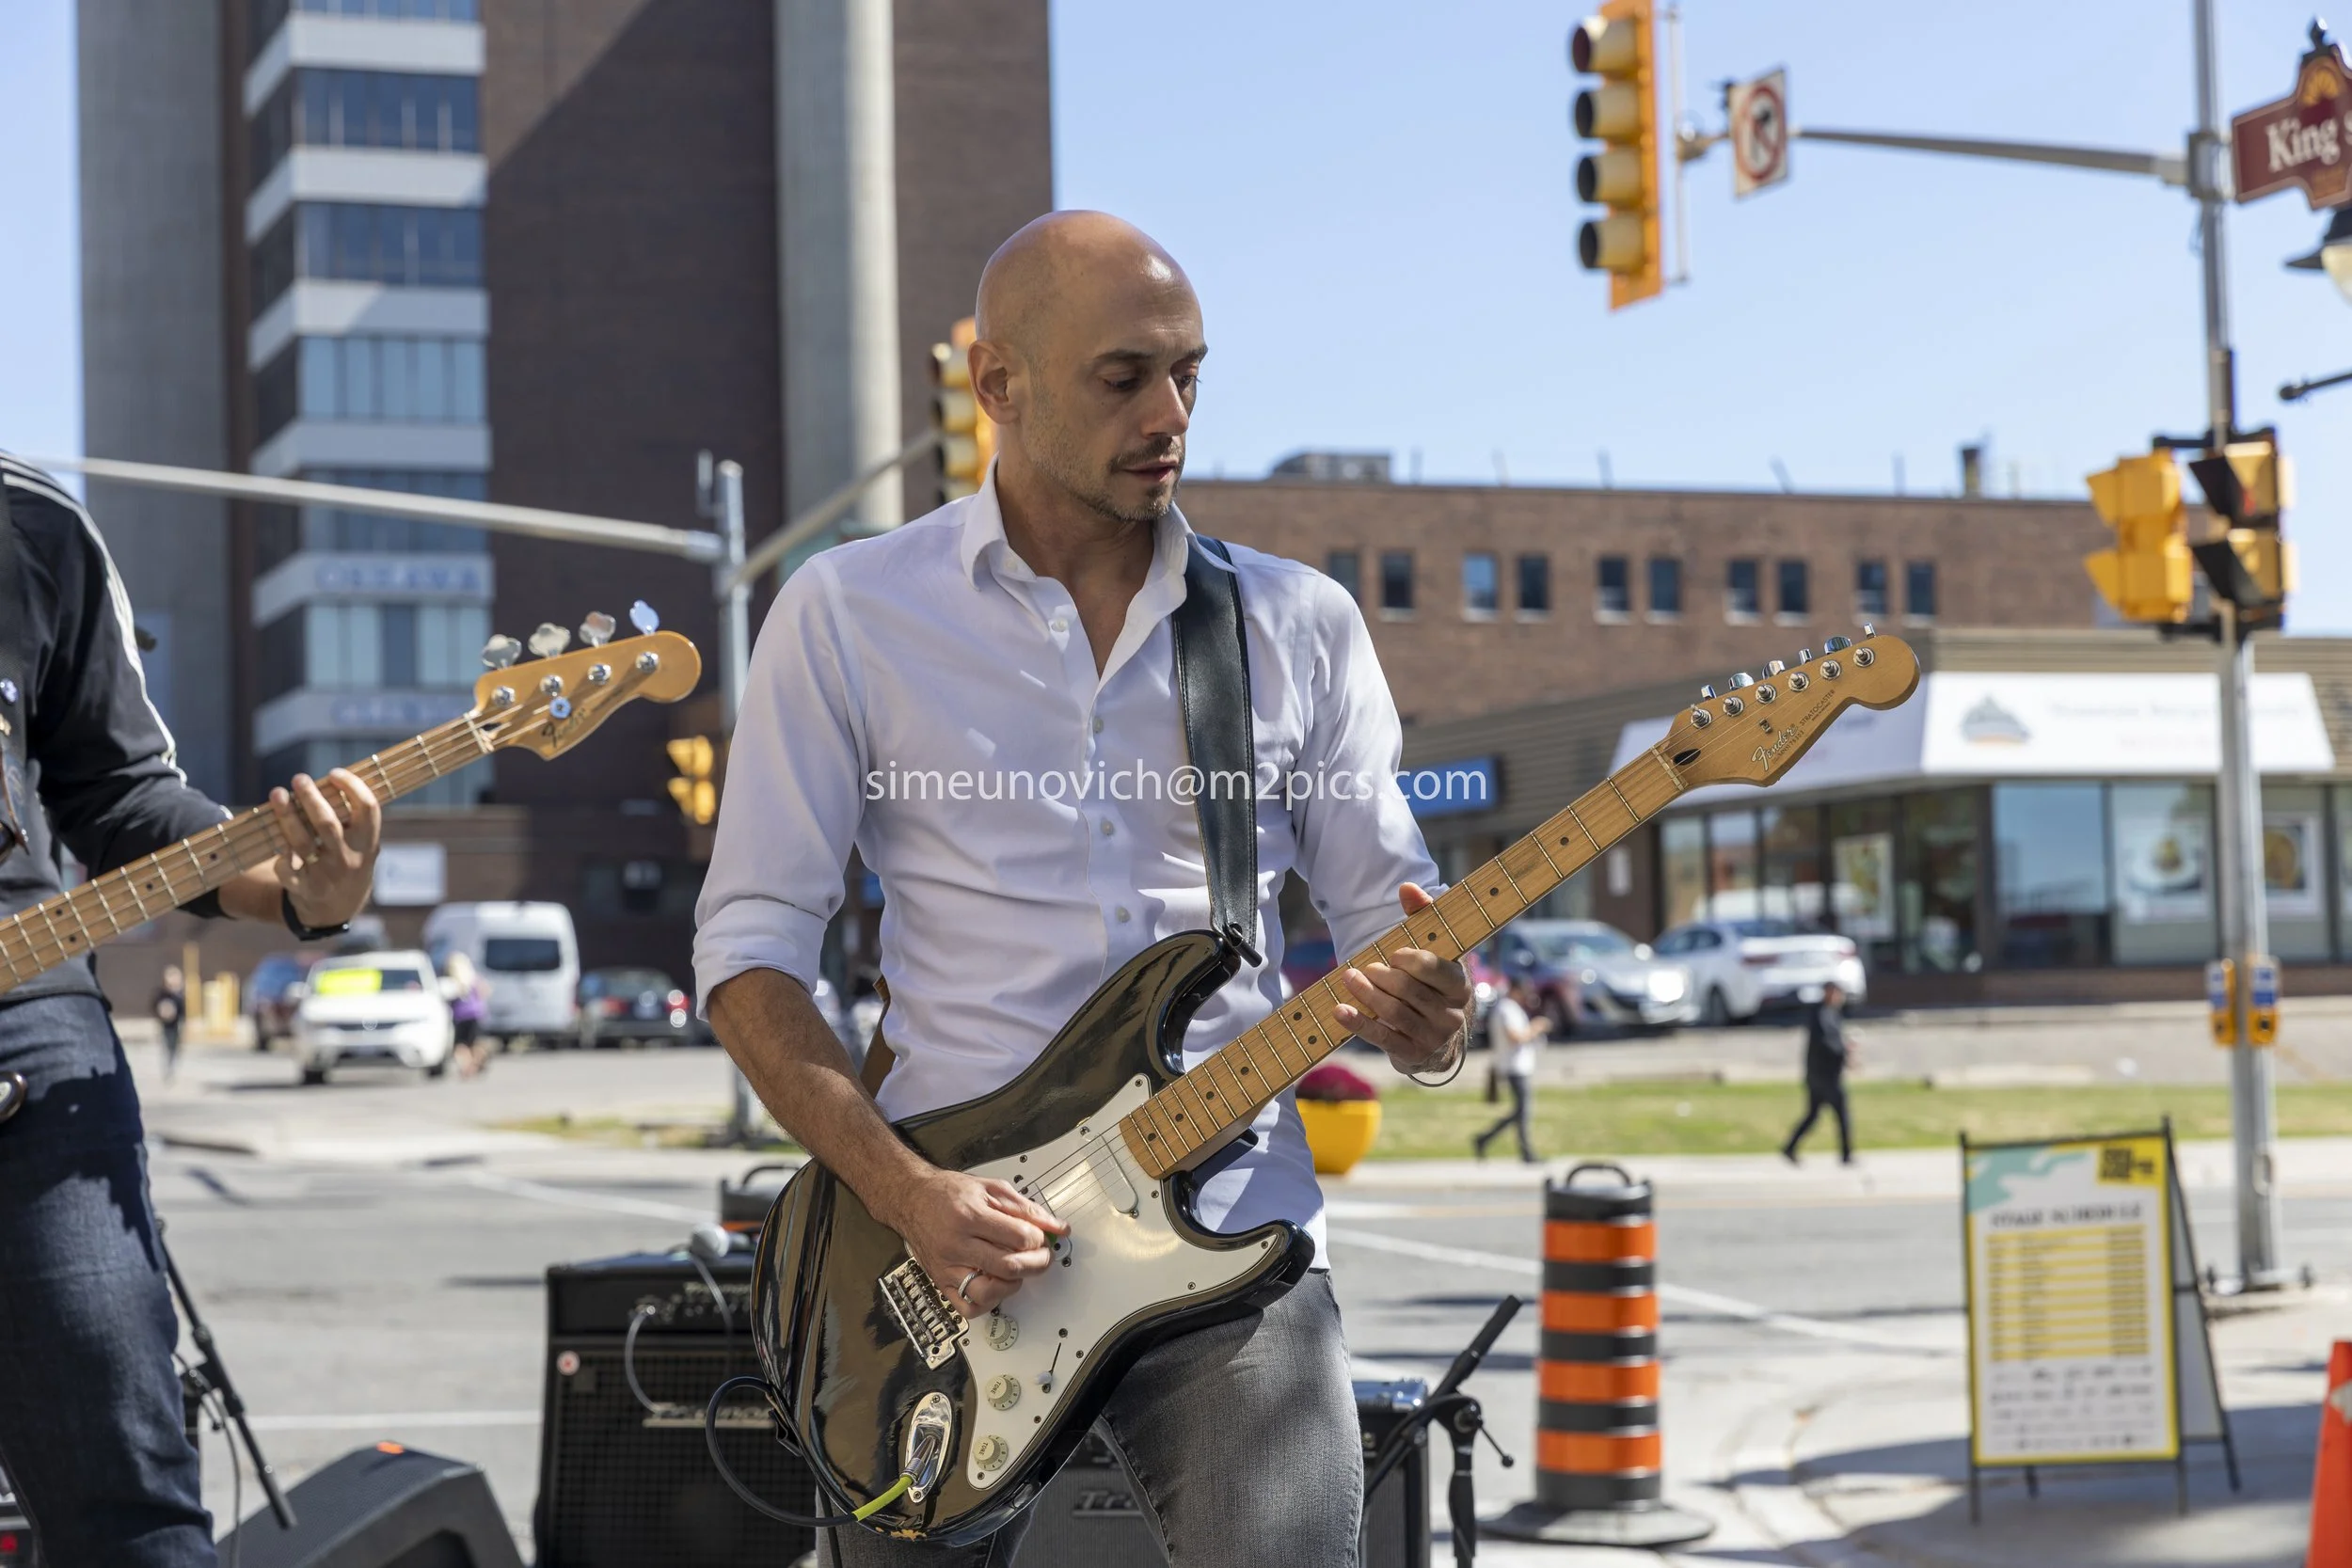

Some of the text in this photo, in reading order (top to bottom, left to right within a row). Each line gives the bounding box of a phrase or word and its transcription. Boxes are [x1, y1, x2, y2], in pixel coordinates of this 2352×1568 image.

[2265, 117, 2342, 173] King
[1751, 724, 1798, 771] Fender
[990, 1381, 1002, 1395] TONE
[978, 1442, 989, 1456] TONE
